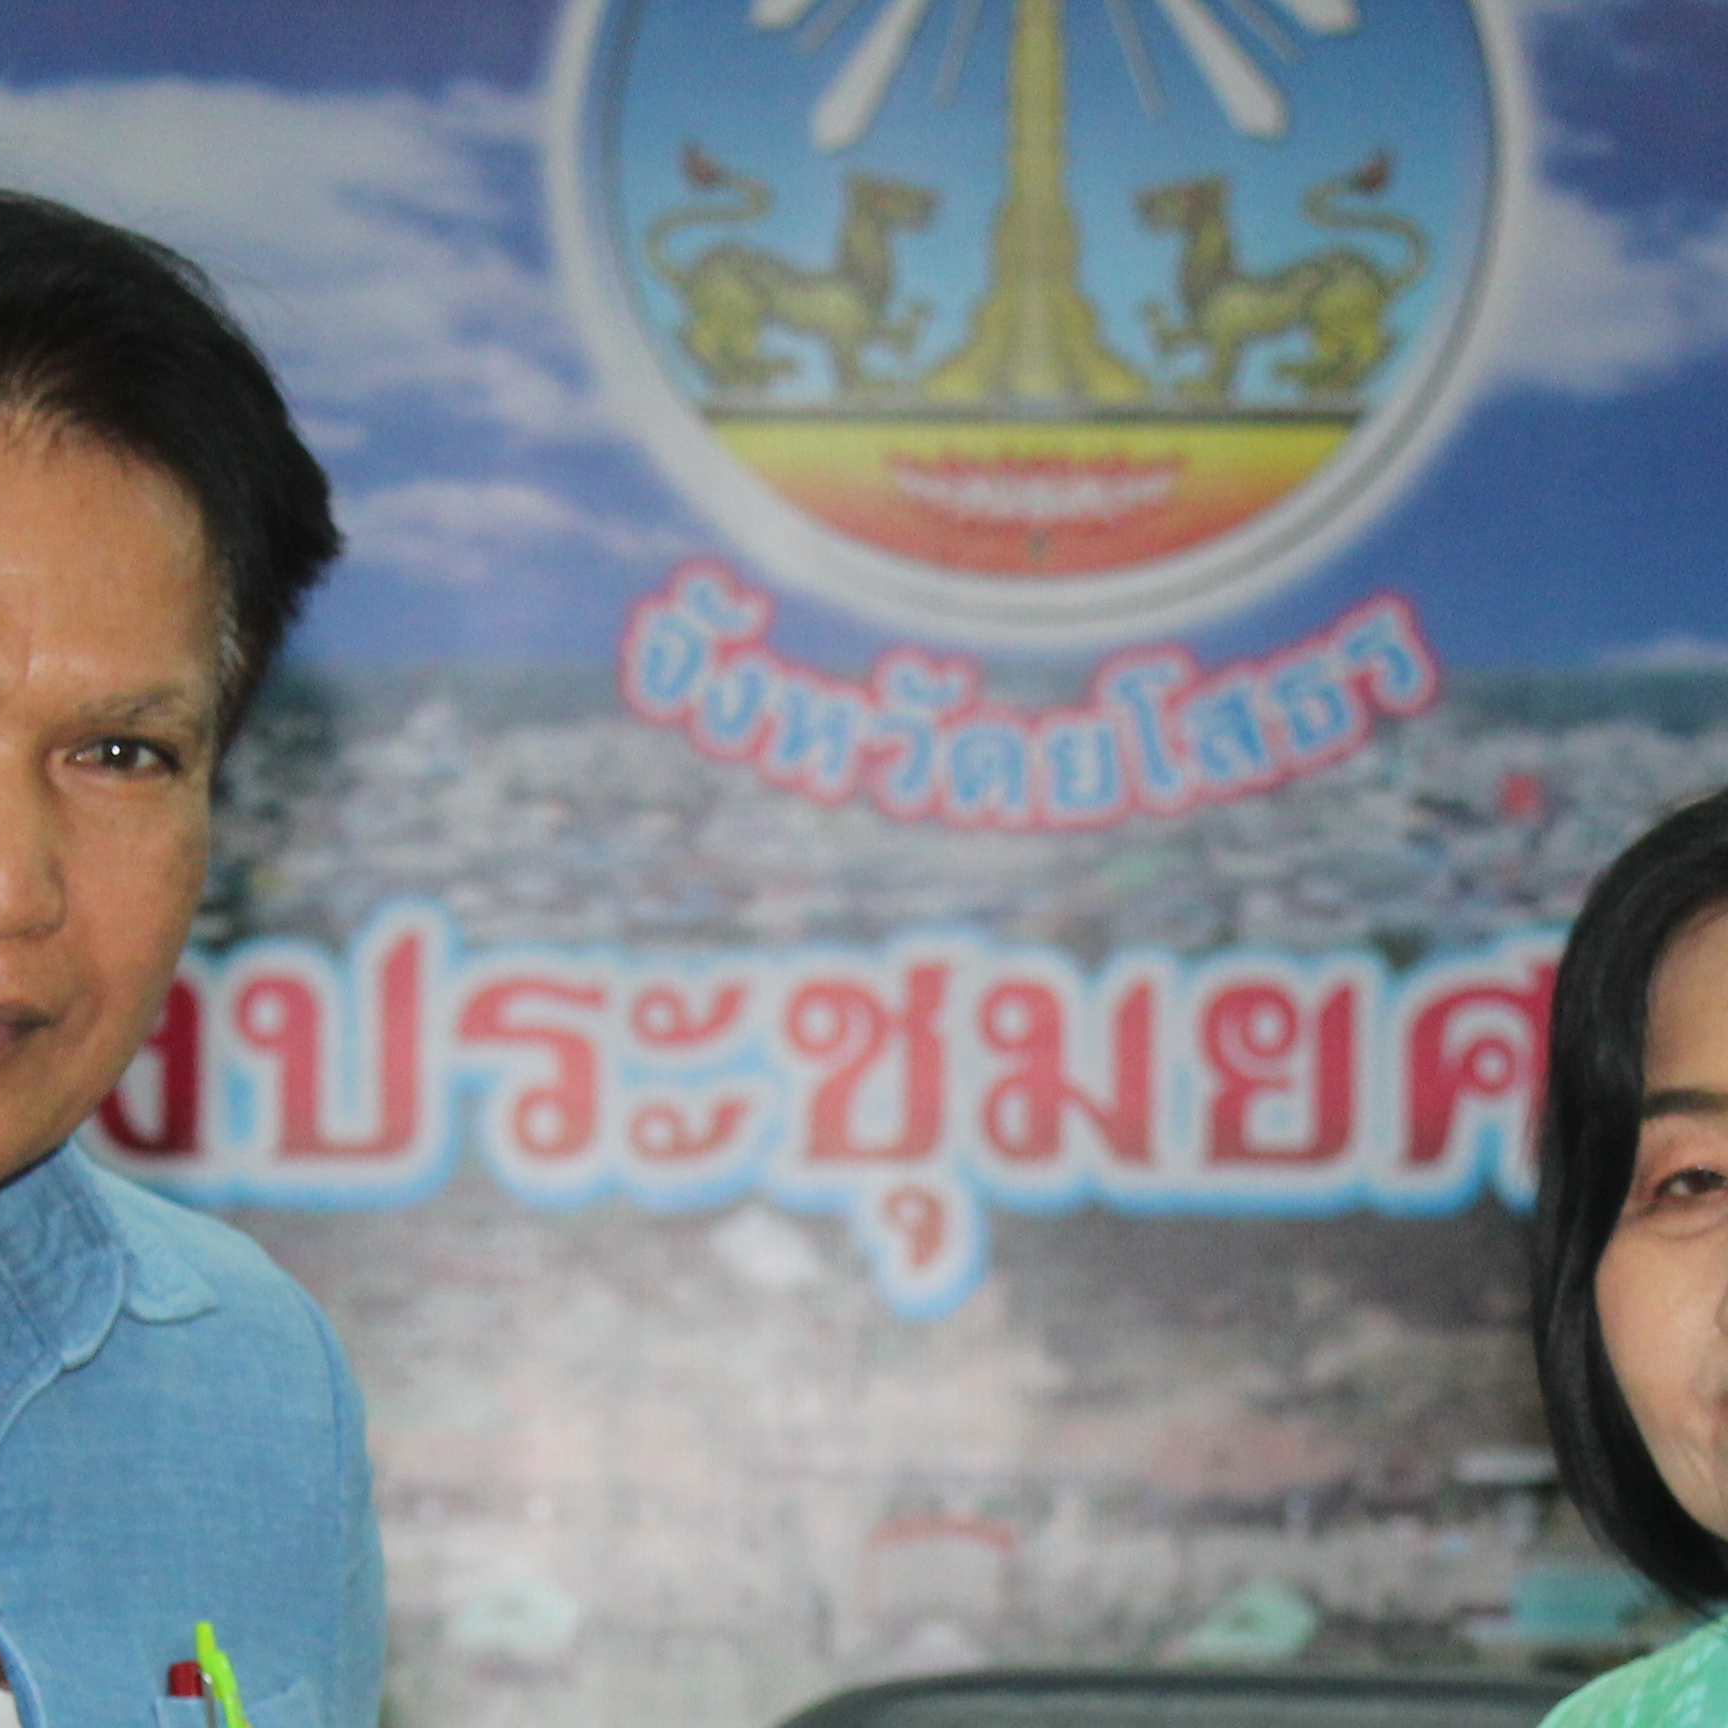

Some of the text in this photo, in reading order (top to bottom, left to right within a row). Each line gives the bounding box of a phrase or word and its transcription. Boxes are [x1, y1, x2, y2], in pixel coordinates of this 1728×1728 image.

[634, 570, 1424, 815] จังหวัดยโสธร
